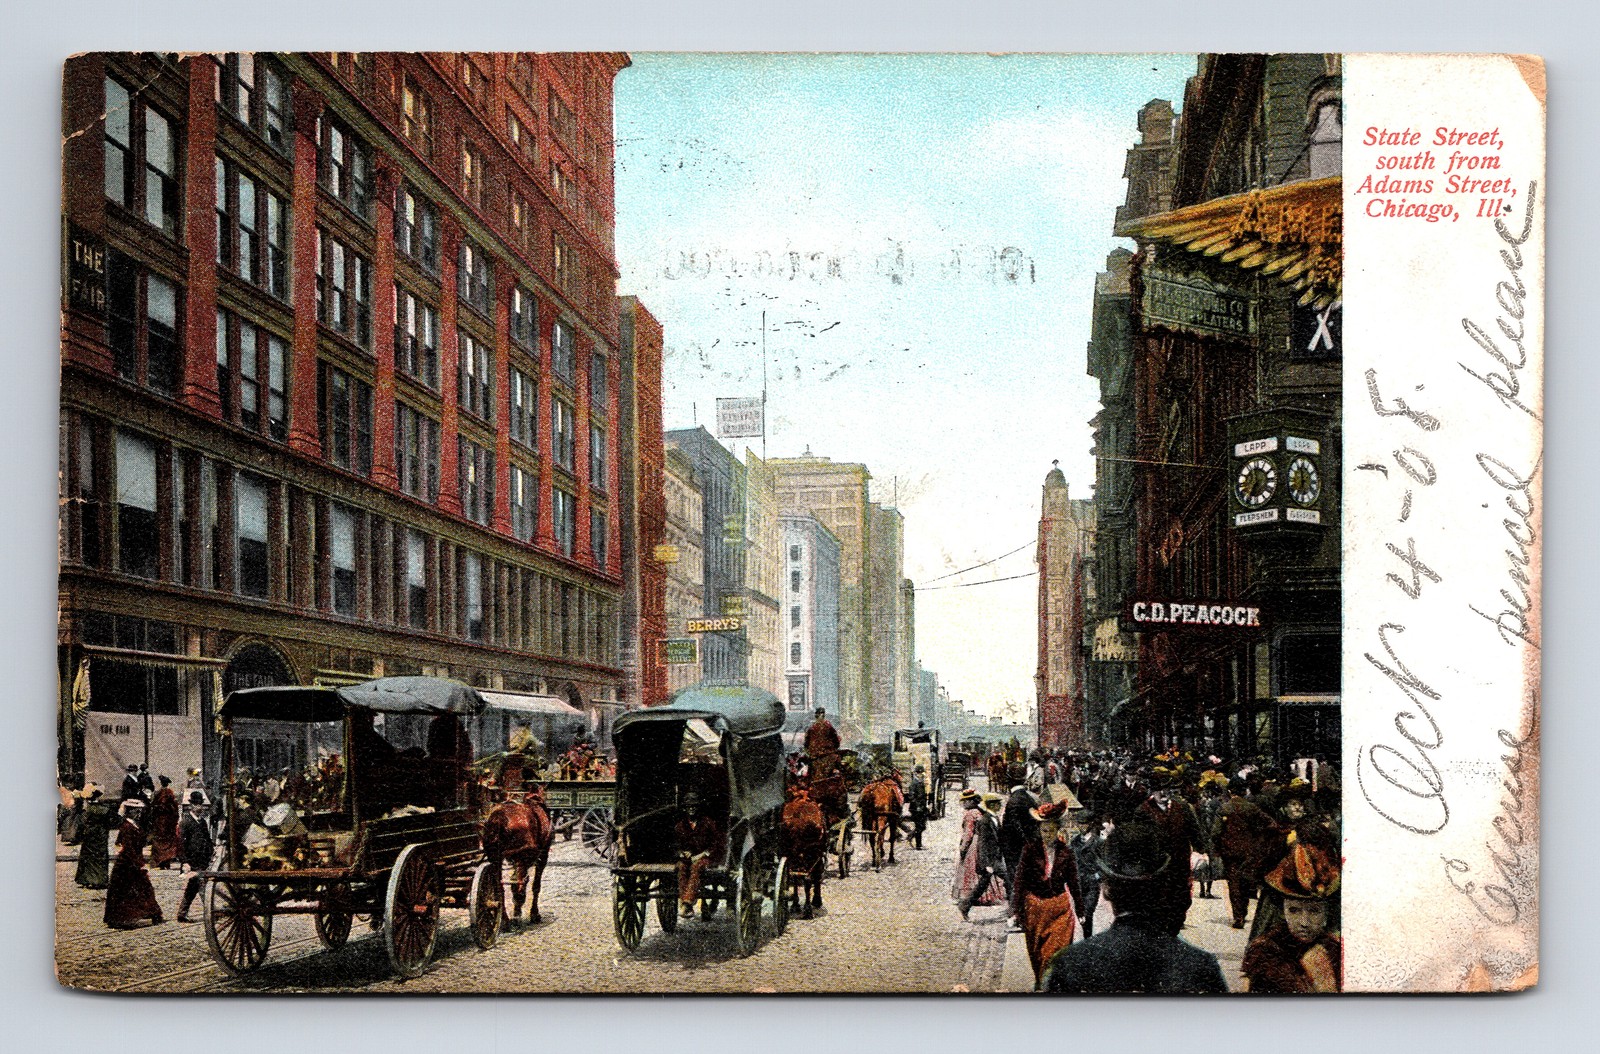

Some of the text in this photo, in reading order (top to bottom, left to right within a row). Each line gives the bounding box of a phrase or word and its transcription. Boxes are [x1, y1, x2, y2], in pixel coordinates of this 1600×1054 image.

[1363, 127, 1504, 150] State Street,
[1376, 151, 1500, 174] south from
[1356, 175, 1517, 198] Adams Street,
[1366, 199, 1459, 222] Chicago,
[72, 240, 104, 274] THE
[1244, 441, 1267, 452] LAPP
[687, 617, 740, 633] BERRY'S
